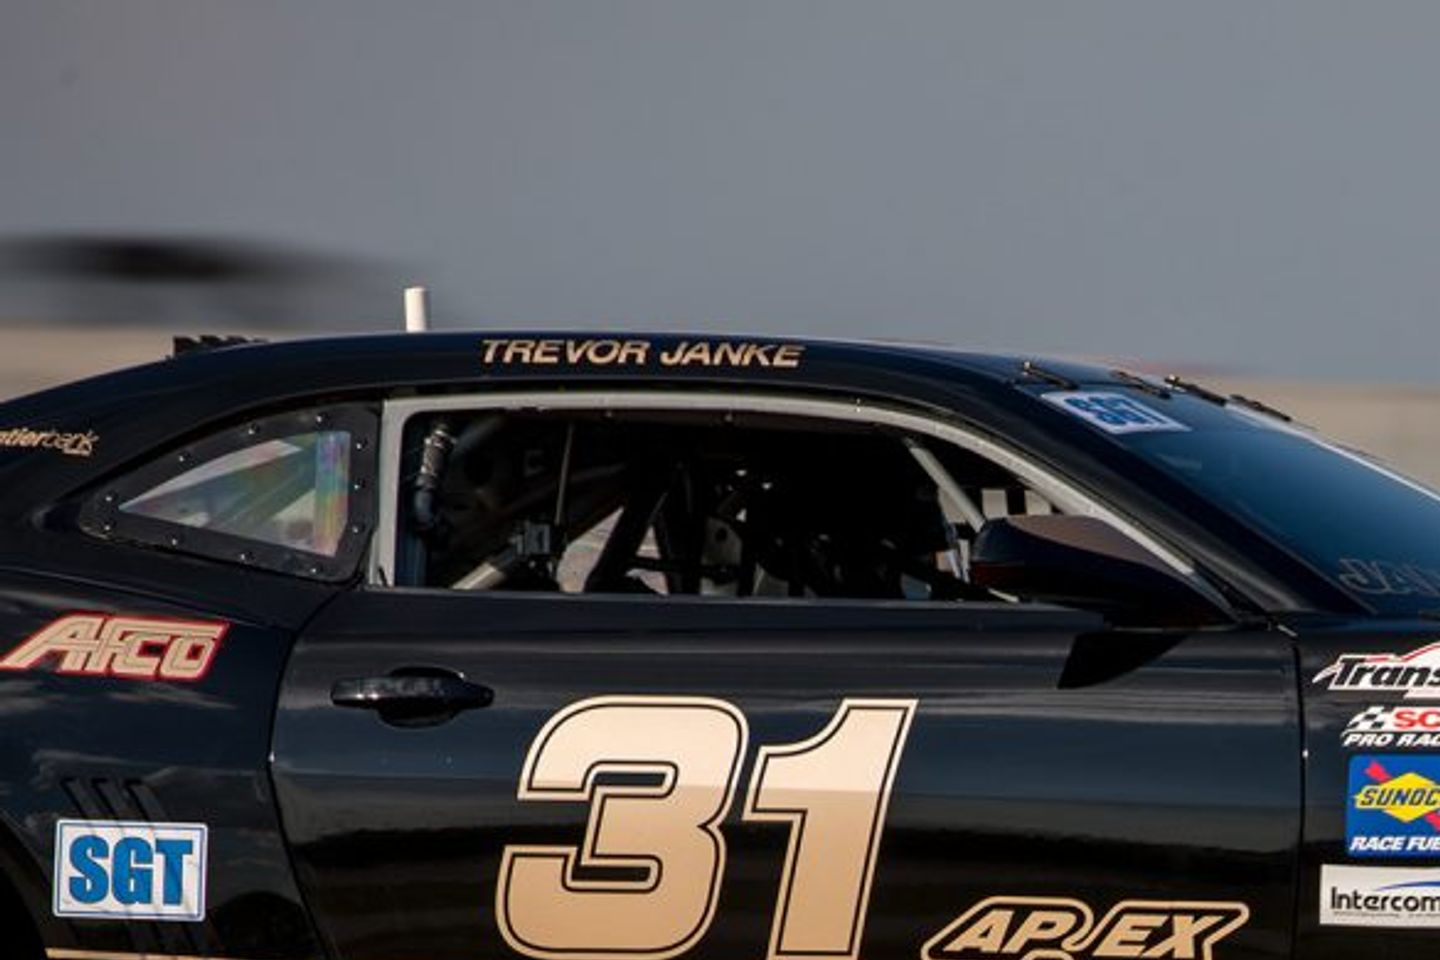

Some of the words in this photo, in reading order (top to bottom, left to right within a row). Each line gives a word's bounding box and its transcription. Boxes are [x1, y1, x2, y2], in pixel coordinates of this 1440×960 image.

[482, 339, 651, 364] TREVOR
[660, 342, 805, 368] JANKE
[0, 612, 230, 680] AFCO
[1342, 732, 1393, 748] PRO
[1350, 835, 1403, 851] RACE
[68, 834, 194, 907] SGT
